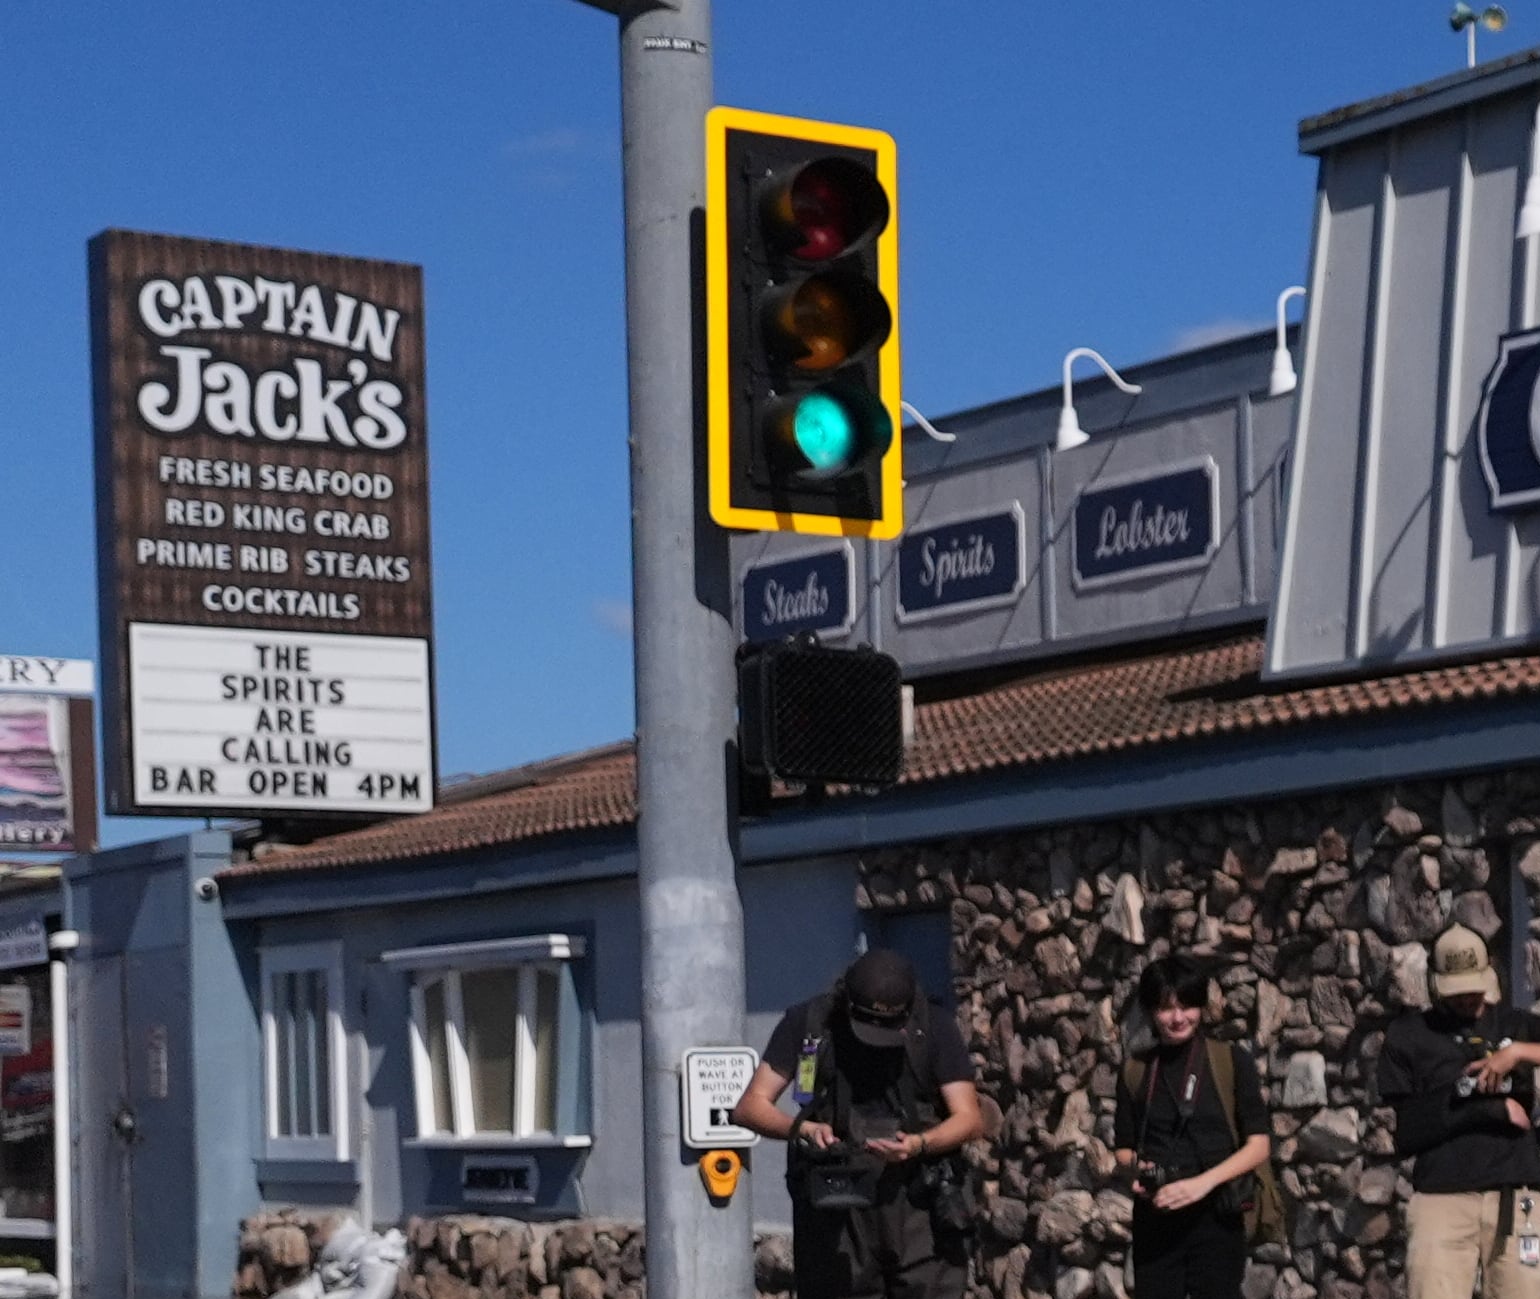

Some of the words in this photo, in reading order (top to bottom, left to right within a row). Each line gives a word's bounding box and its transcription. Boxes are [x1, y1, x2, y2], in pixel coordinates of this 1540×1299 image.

[138, 275, 400, 362] CAPTAIN
[138, 345, 407, 449] Jack's
[159, 456, 251, 488] FRESH
[259, 464, 394, 500] SEAFOOD
[165, 498, 226, 528] RED
[233, 504, 307, 534] KING
[313, 510, 391, 541] CRAB
[1096, 500, 1192, 560] Lobster
[136, 538, 233, 570] PRIME
[240, 545, 289, 574] RIB
[304, 550, 411, 583] STEAKS
[919, 534, 996, 598] Spirits
[202, 584, 361, 620] COCKTAILS
[761, 570, 830, 627] Steaks
[0, 657, 66, 686] RY
[255, 645, 311, 672] THE
[221, 675, 345, 705] SPIRITS
[255, 707, 315, 735] ARE
[221, 737, 353, 767] CALLING
[151, 766, 217, 794] BAR
[248, 769, 328, 797] OPEN
[356, 774, 420, 799] 4PM
[697, 1057, 726, 1068] PUSH
[731, 1057, 745, 1067] OR
[698, 1070, 725, 1079] WAVE
[731, 1070, 744, 1079] AT
[701, 1082, 743, 1092] BUTTON
[711, 1095, 733, 1105] FOR
